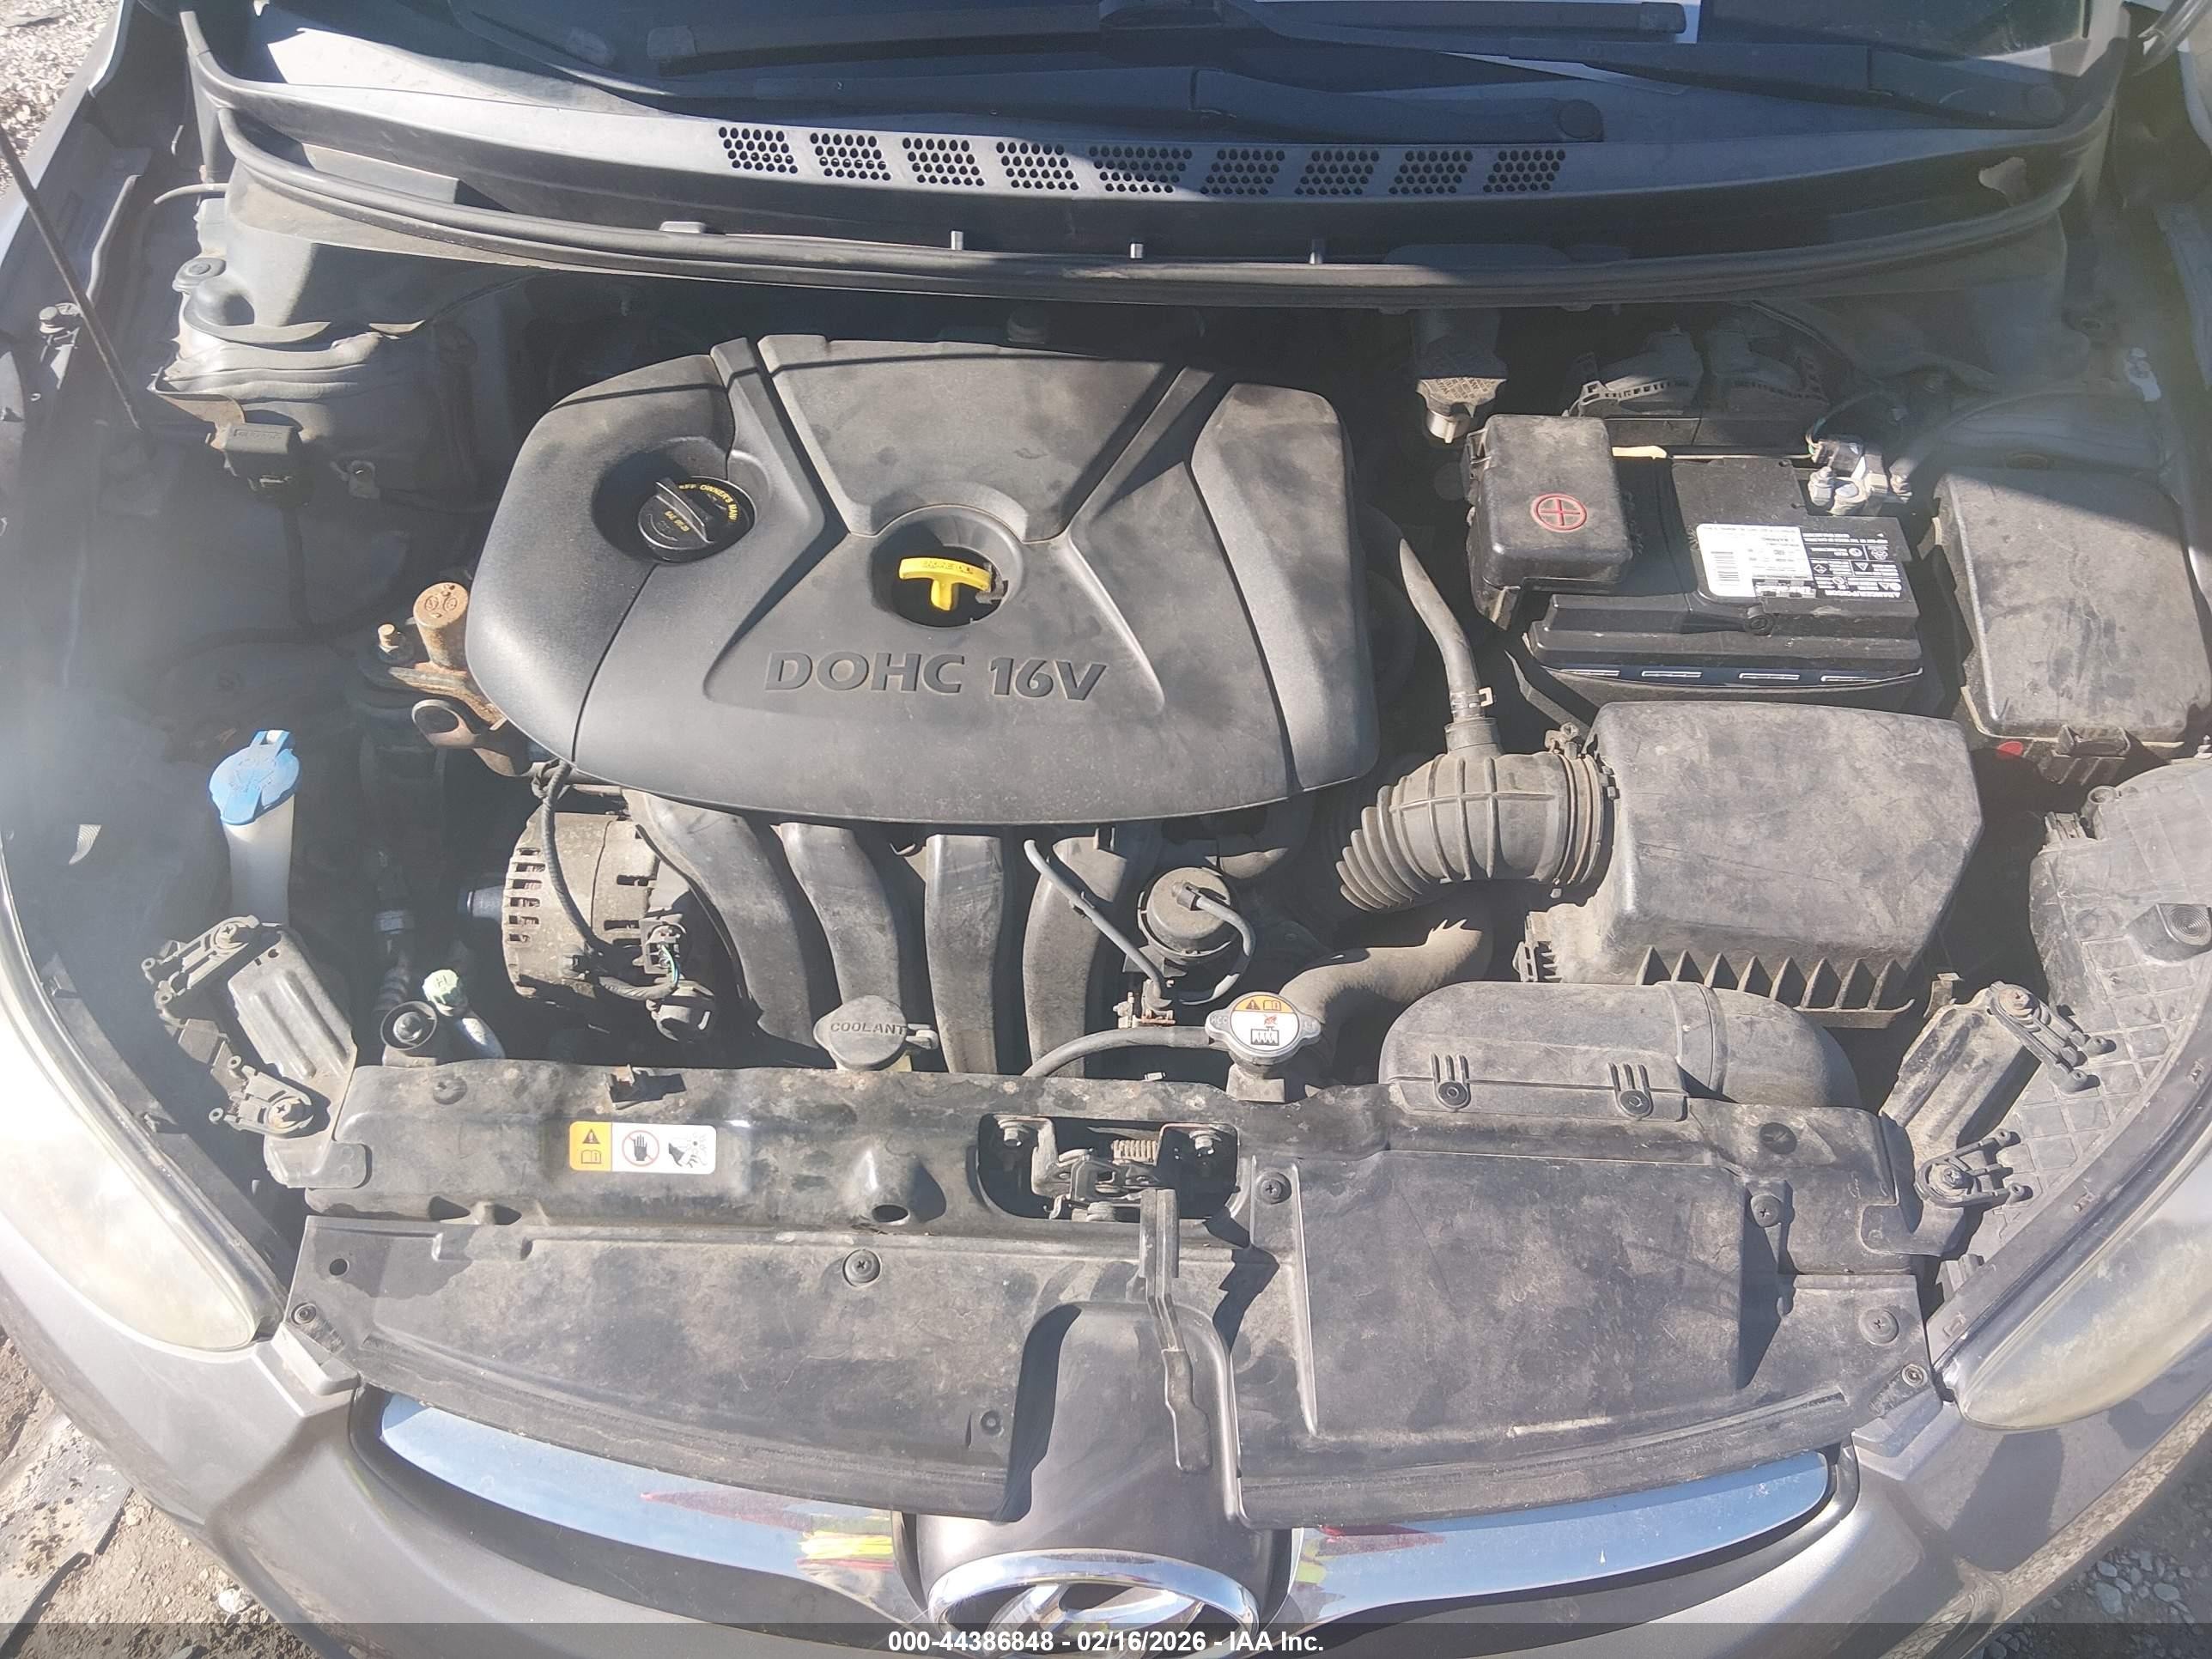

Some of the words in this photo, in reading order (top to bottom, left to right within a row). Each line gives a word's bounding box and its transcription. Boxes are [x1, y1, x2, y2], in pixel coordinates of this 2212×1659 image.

[699, 483, 734, 504] OWNER'S
[766, 651, 967, 695] DOHC
[989, 656, 1108, 702] 16V
[830, 1022, 908, 1036] COOLANT
